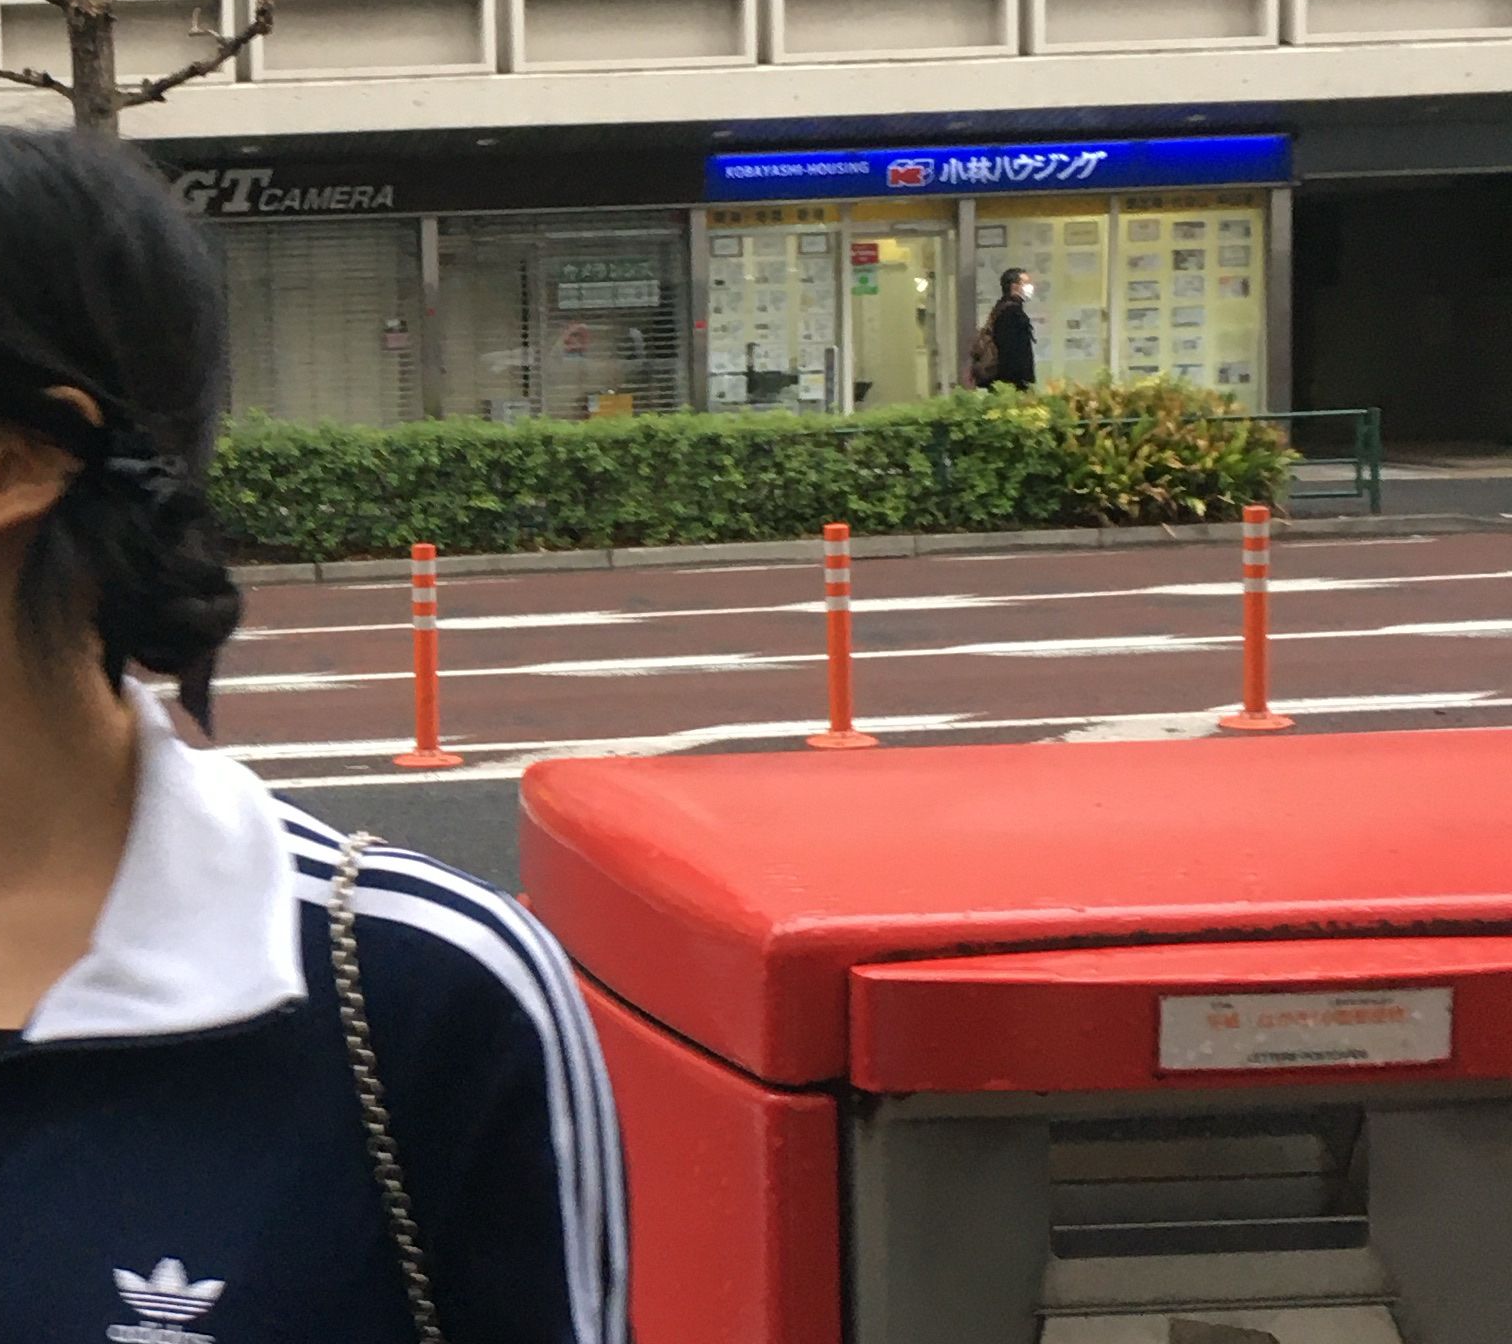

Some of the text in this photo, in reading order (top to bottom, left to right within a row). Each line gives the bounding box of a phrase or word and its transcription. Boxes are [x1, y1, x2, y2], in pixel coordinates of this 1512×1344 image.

[725, 161, 870, 179] KOBAYASHI-HOUSING
[939, 150, 1108, 184] 小林ハウジング
[258, 185, 395, 211] CAMERA
